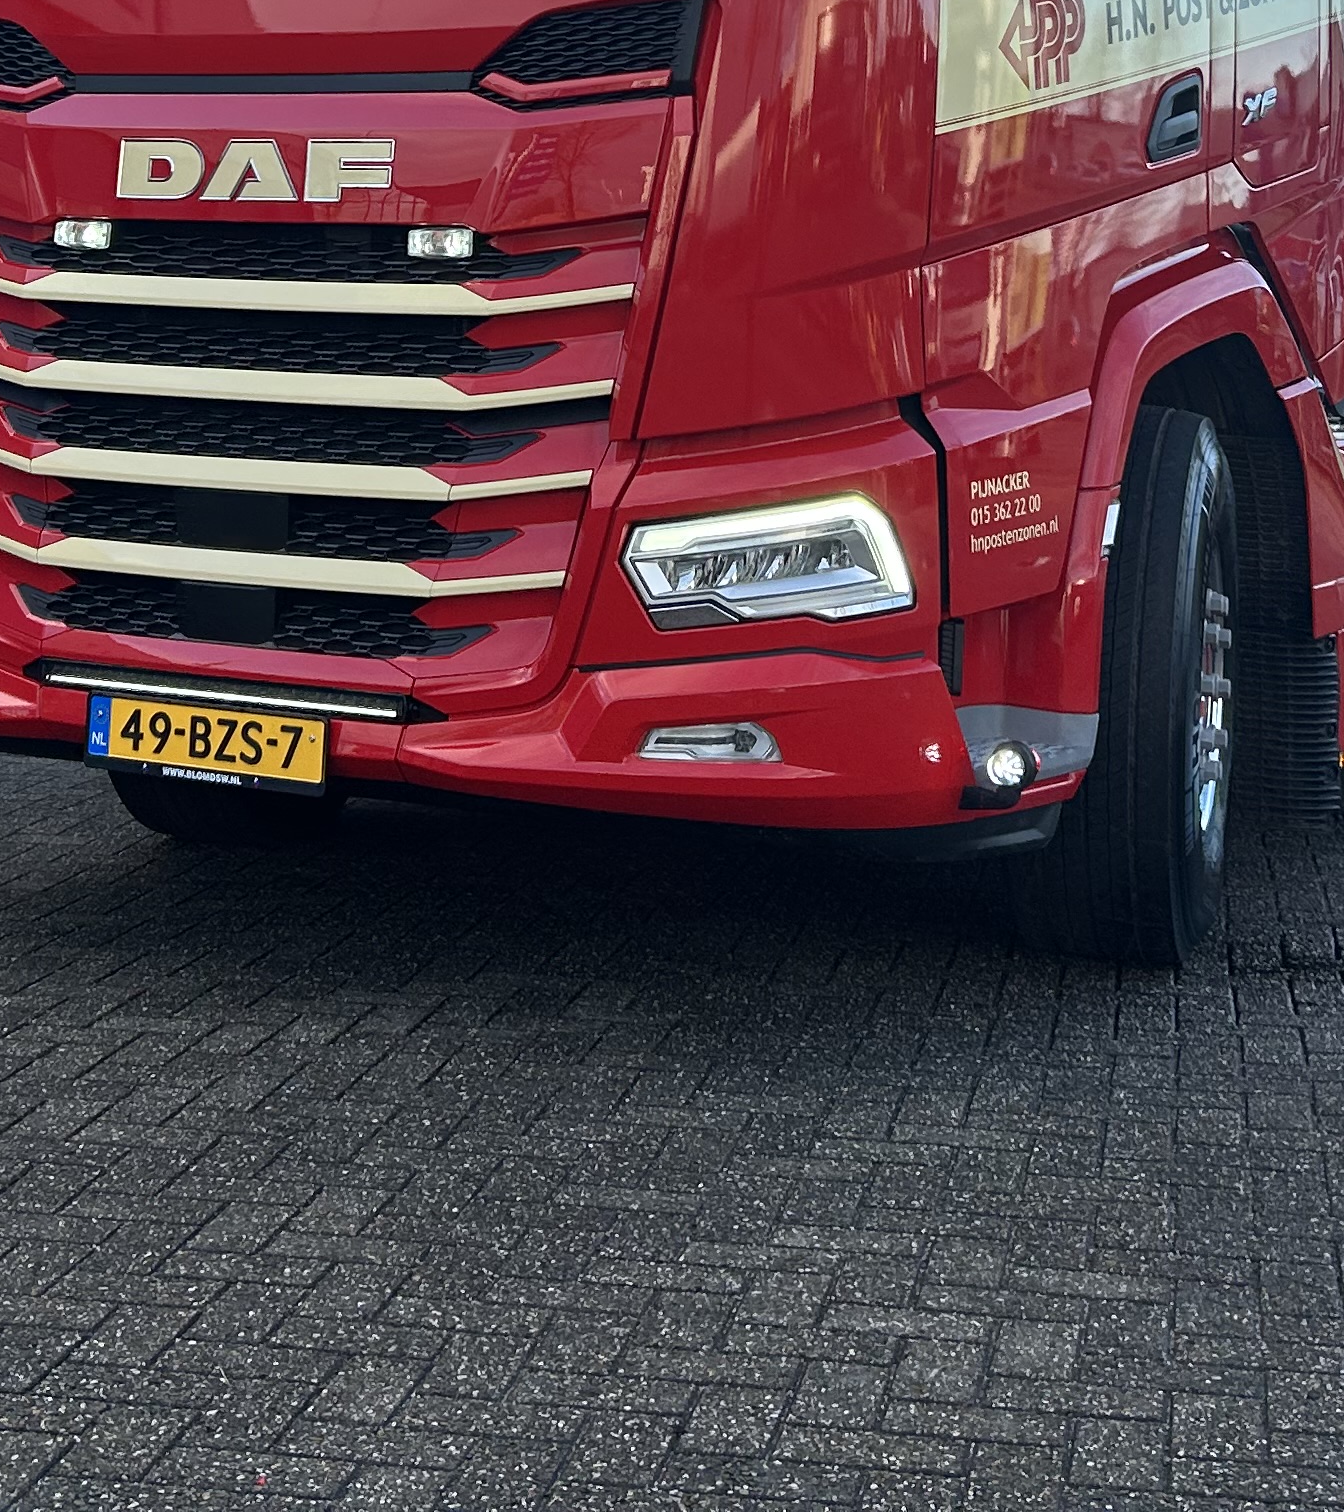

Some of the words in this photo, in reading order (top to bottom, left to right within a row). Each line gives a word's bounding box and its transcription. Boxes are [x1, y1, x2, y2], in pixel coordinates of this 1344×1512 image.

[1241, 86, 1278, 127] XF
[116, 137, 396, 203] DAF
[970, 470, 1030, 500] PIJNACKER
[970, 504, 991, 527] 015
[993, 499, 1012, 522] 362
[1014, 496, 1027, 518] 22
[1028, 493, 1041, 513] 00
[969, 515, 1059, 555] hnpostenzonen.nl
[91, 730, 107, 747] NL
[119, 708, 304, 770] 49-BZS-7
